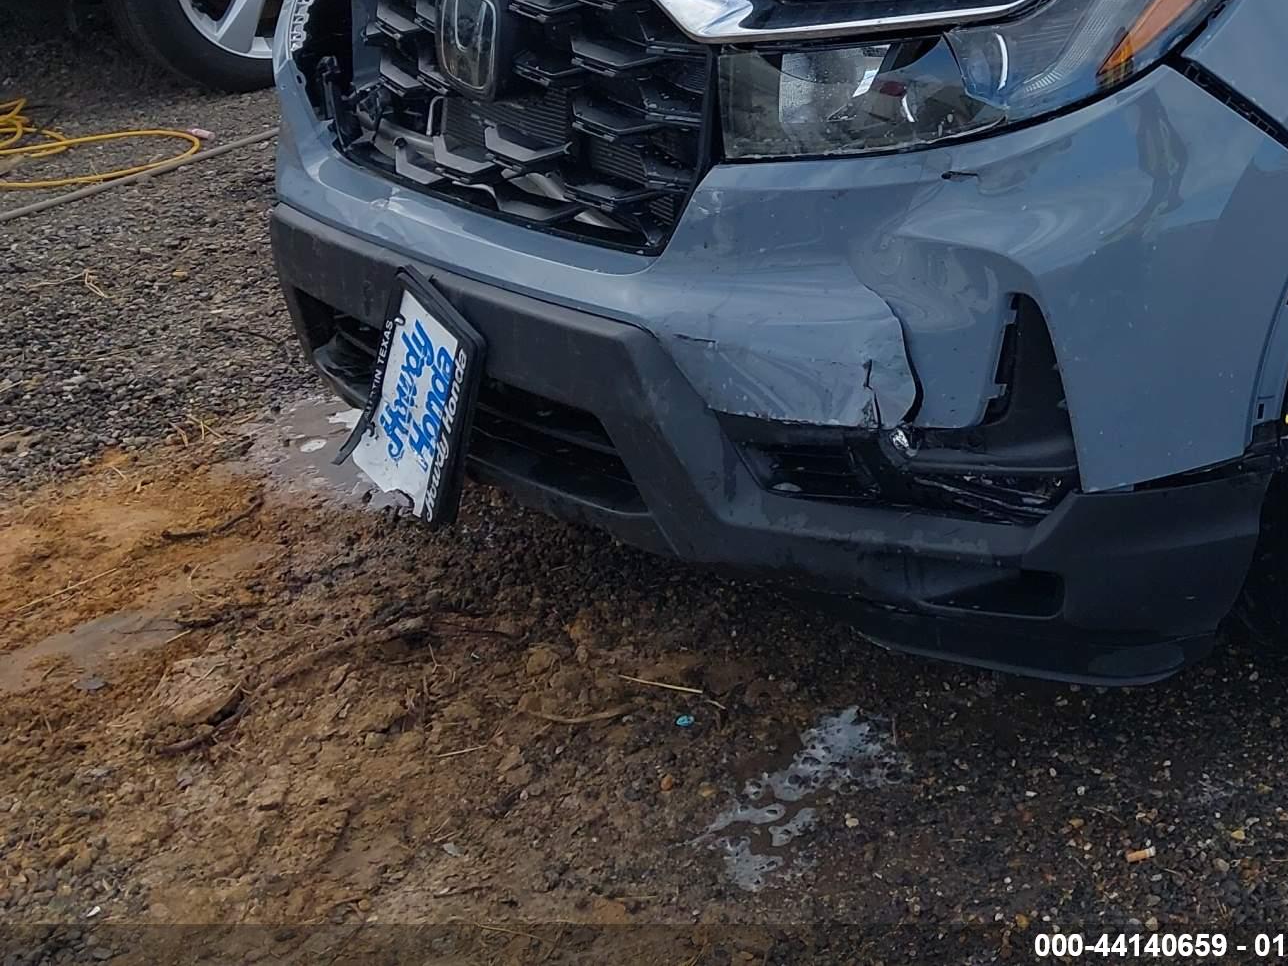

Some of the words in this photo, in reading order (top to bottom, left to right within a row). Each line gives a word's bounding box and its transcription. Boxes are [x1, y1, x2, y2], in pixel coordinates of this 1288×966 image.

[377, 320, 394, 365] TEXAS
[380, 318, 436, 461] Howdy
[408, 345, 456, 470] Honda
[425, 438, 450, 523] Howdy
[441, 347, 468, 434] Honda
